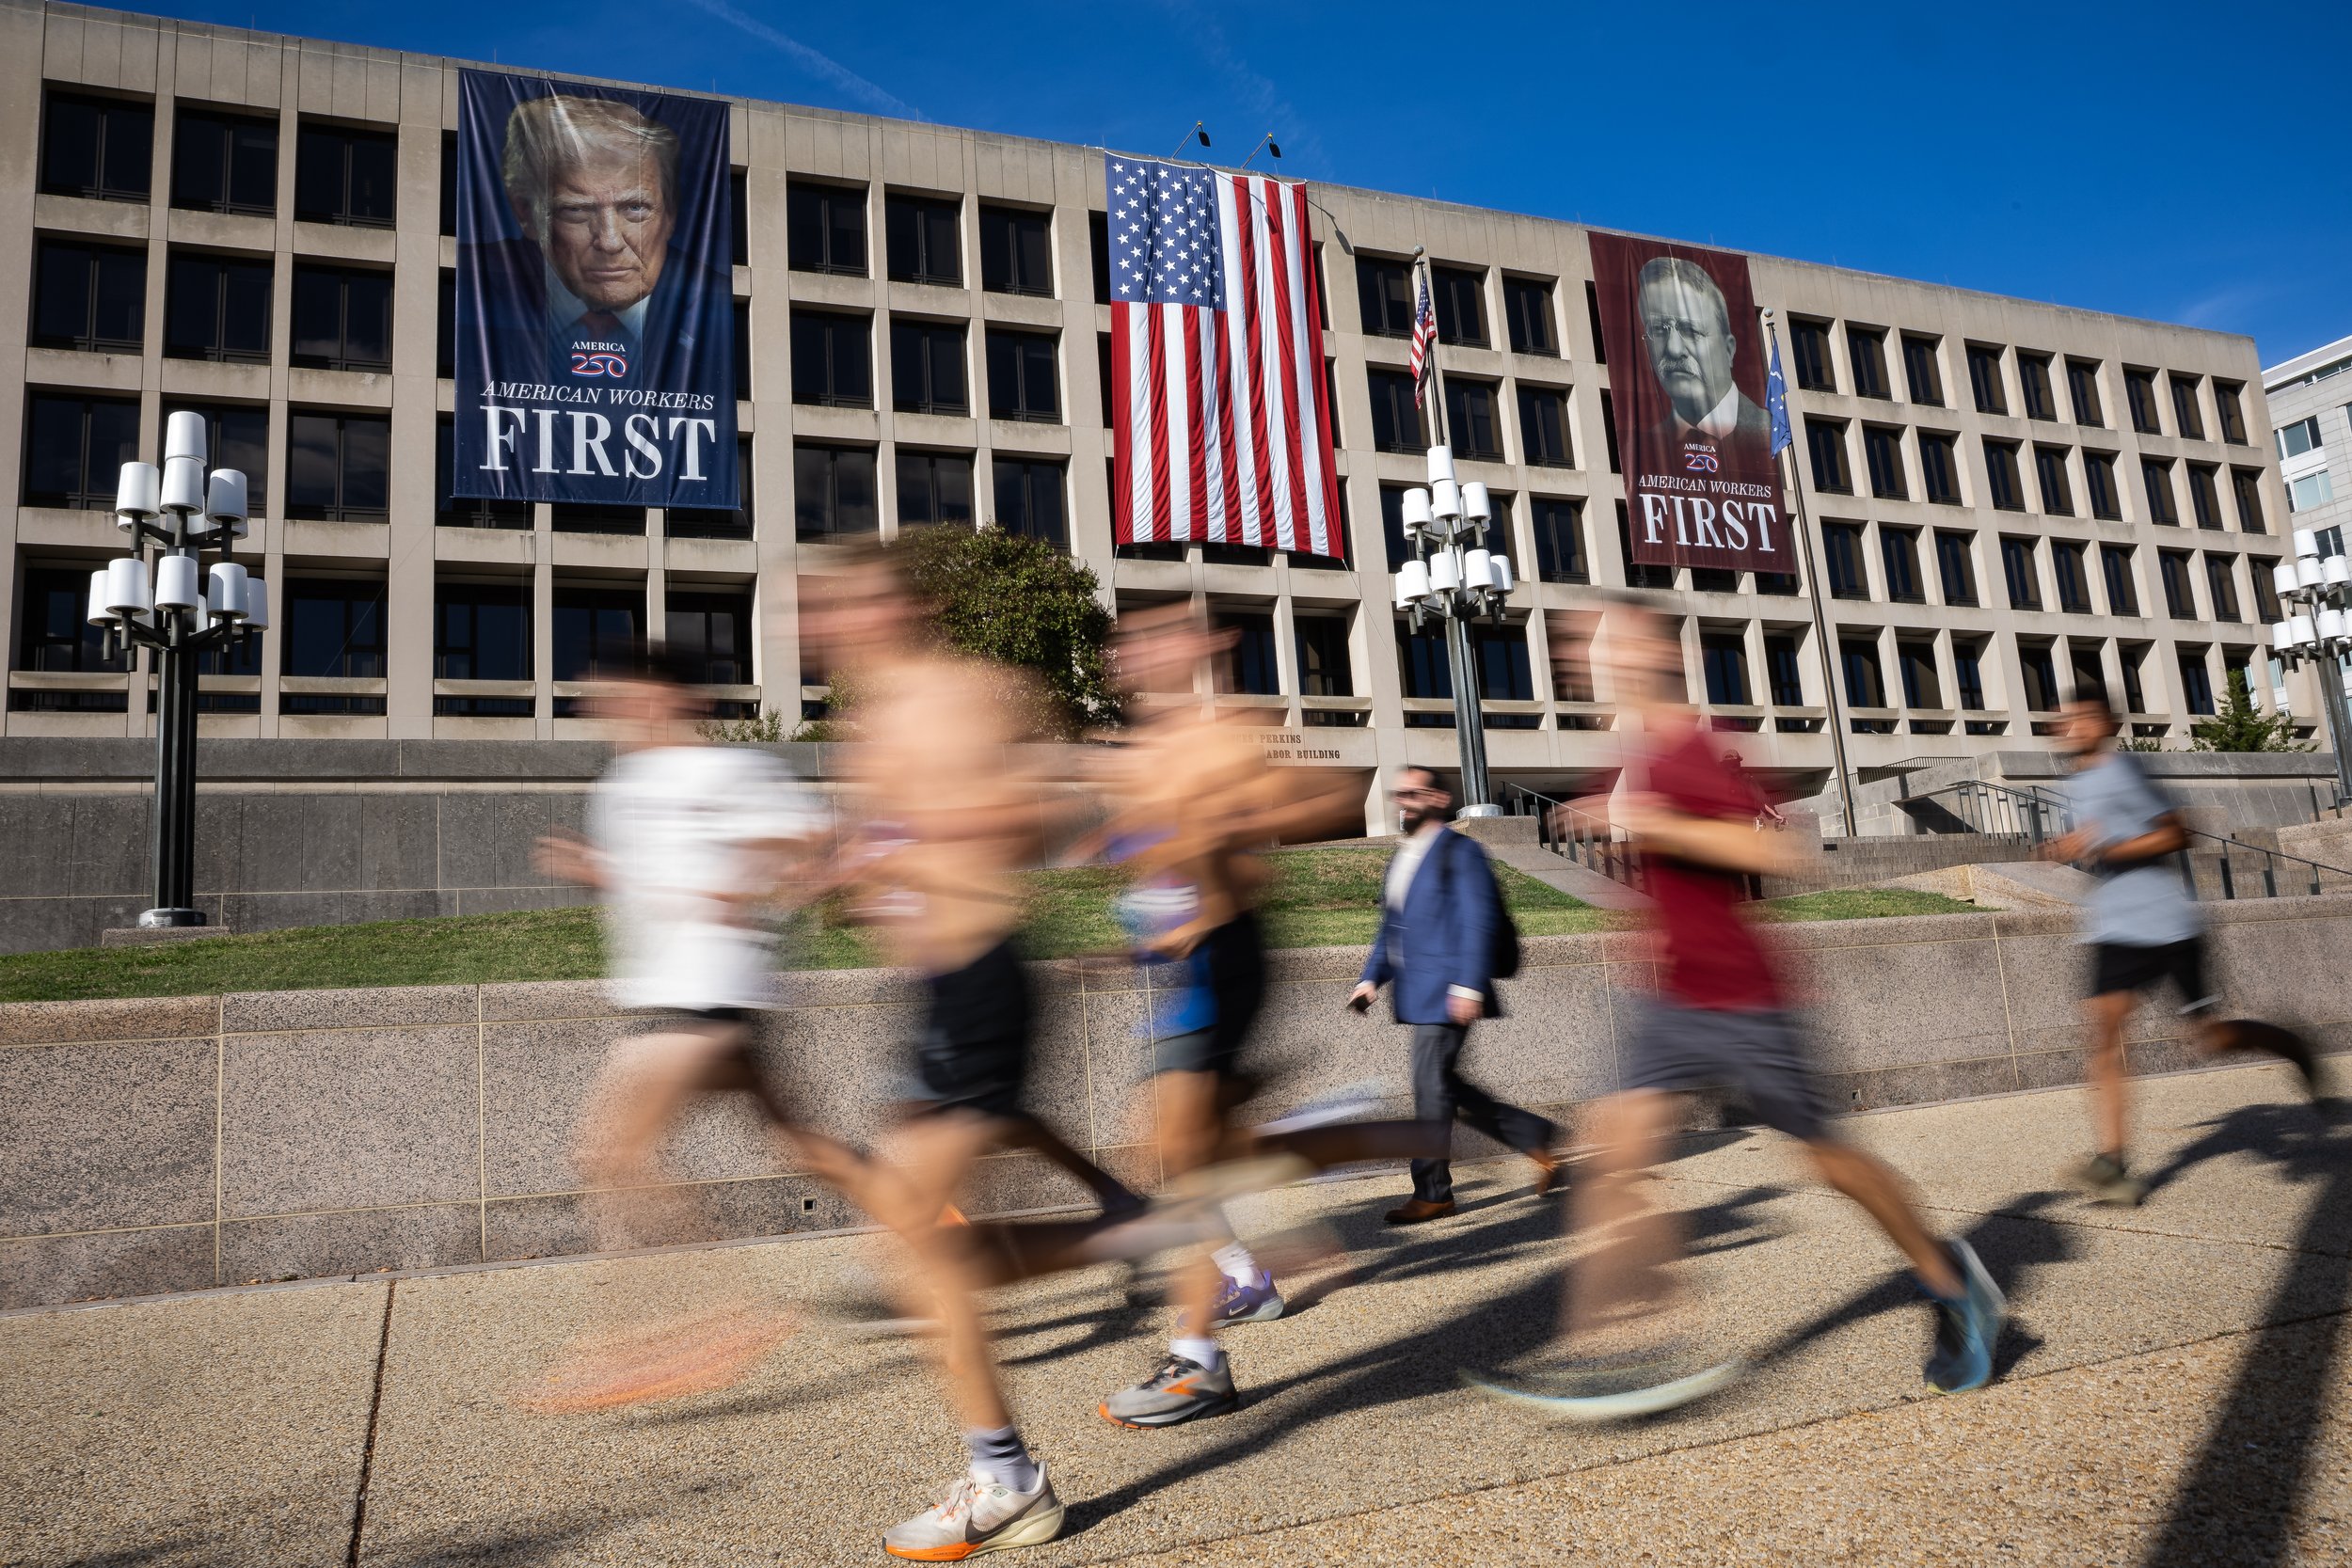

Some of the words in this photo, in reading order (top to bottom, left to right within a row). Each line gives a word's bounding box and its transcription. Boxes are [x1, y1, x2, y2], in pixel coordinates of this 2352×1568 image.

[572, 341, 627, 352] AMERICA
[572, 353, 628, 378] 250
[480, 380, 602, 404] AMERICAN
[609, 388, 714, 410] WORKERS
[479, 405, 716, 481] FIRST
[1684, 443, 1716, 452] AMERICA
[1685, 453, 1719, 473] 250
[1639, 475, 1707, 492] AMERICAN
[1709, 481, 1772, 498] WORKERS
[1639, 494, 1777, 551] FIRST
[1260, 735, 1301, 744] PERKINS
[1266, 750, 1292, 759] ABOR
[1296, 750, 1341, 759] BUILDING
